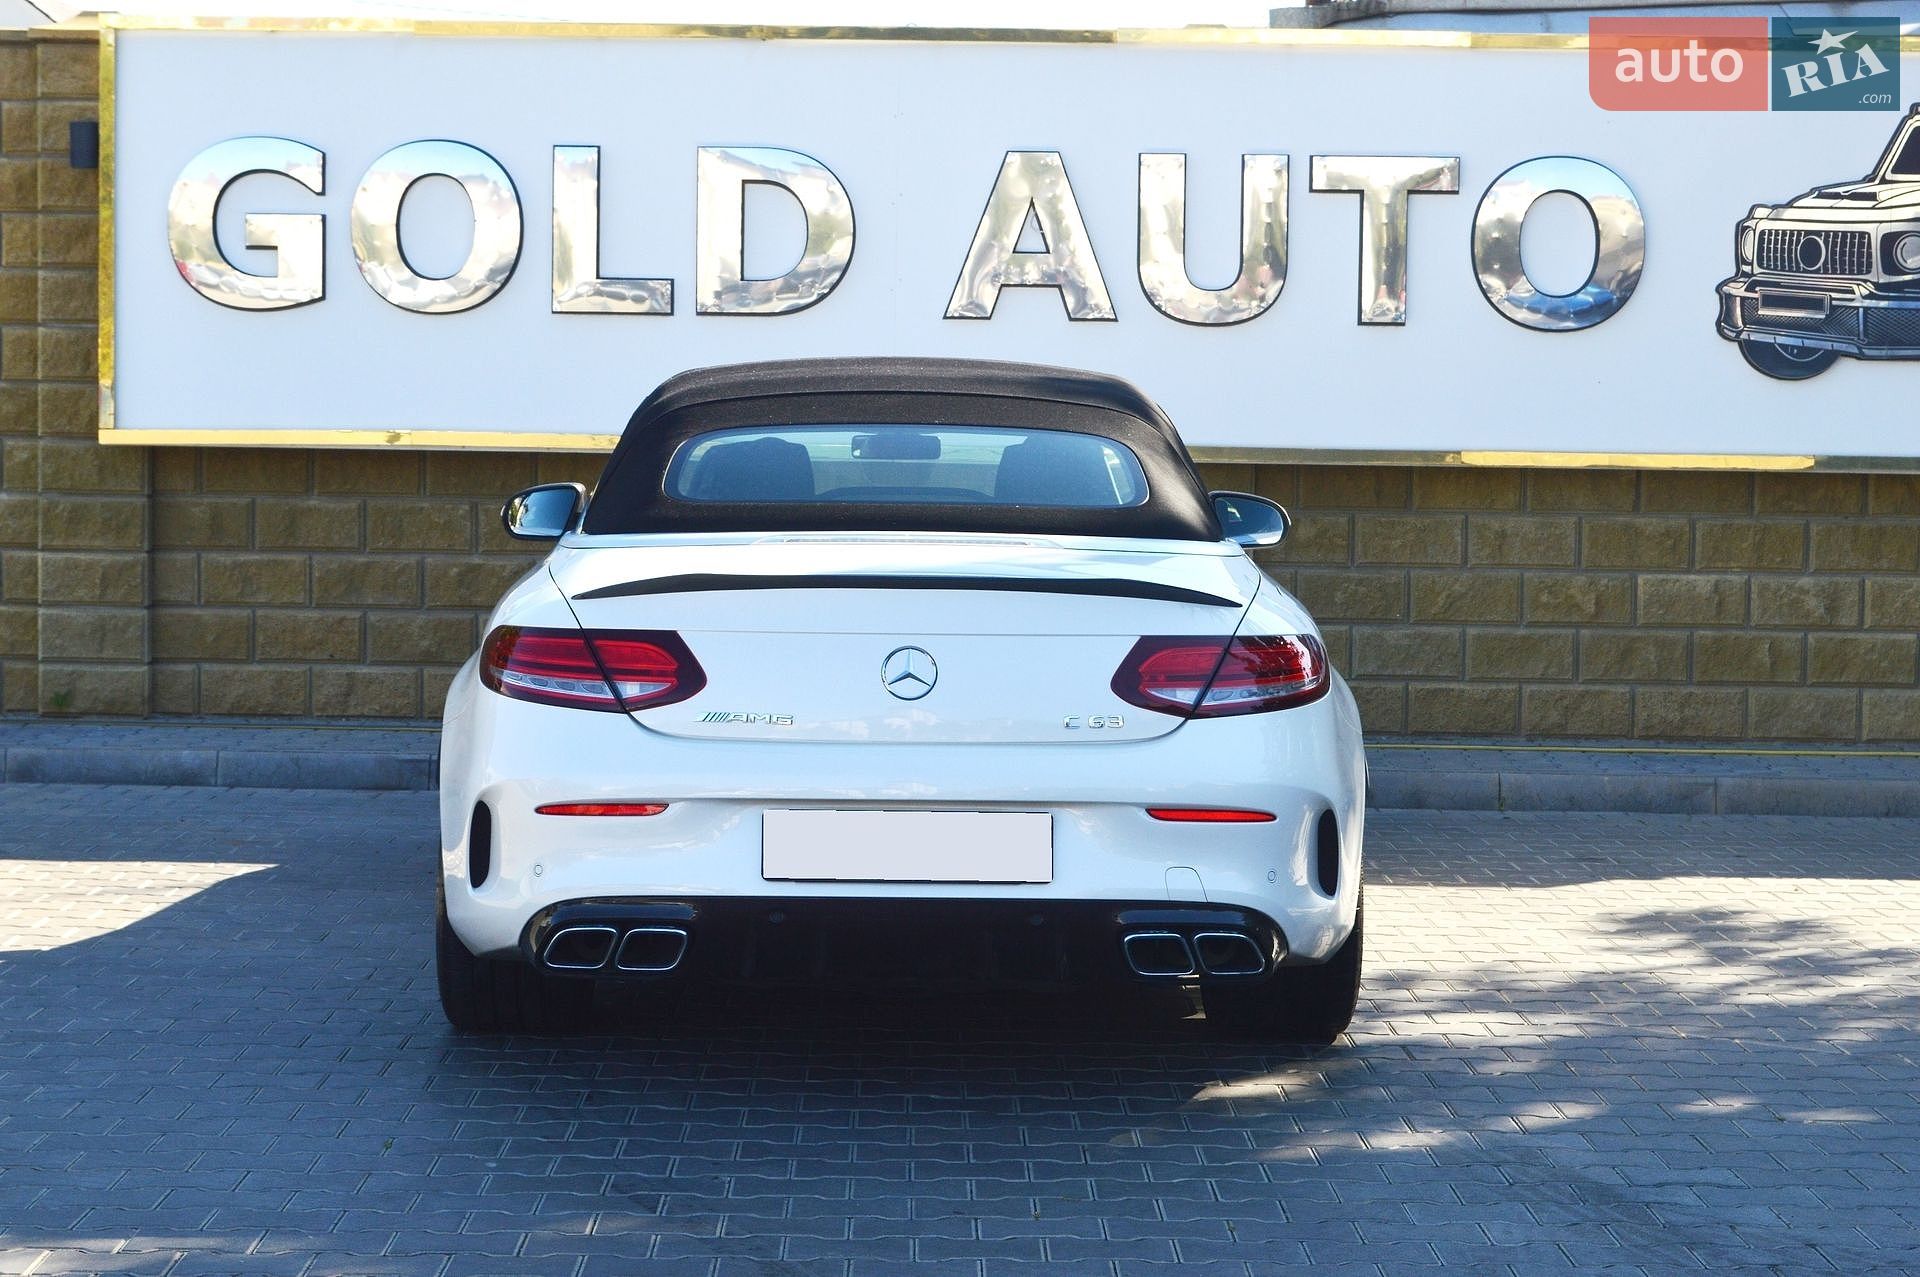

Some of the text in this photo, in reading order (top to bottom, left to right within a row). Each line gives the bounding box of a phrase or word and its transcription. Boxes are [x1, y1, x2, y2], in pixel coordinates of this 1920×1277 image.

[167, 135, 1646, 333] GOLD AUTO
[725, 711, 795, 726] AMG
[1063, 714, 1125, 729] C 63
